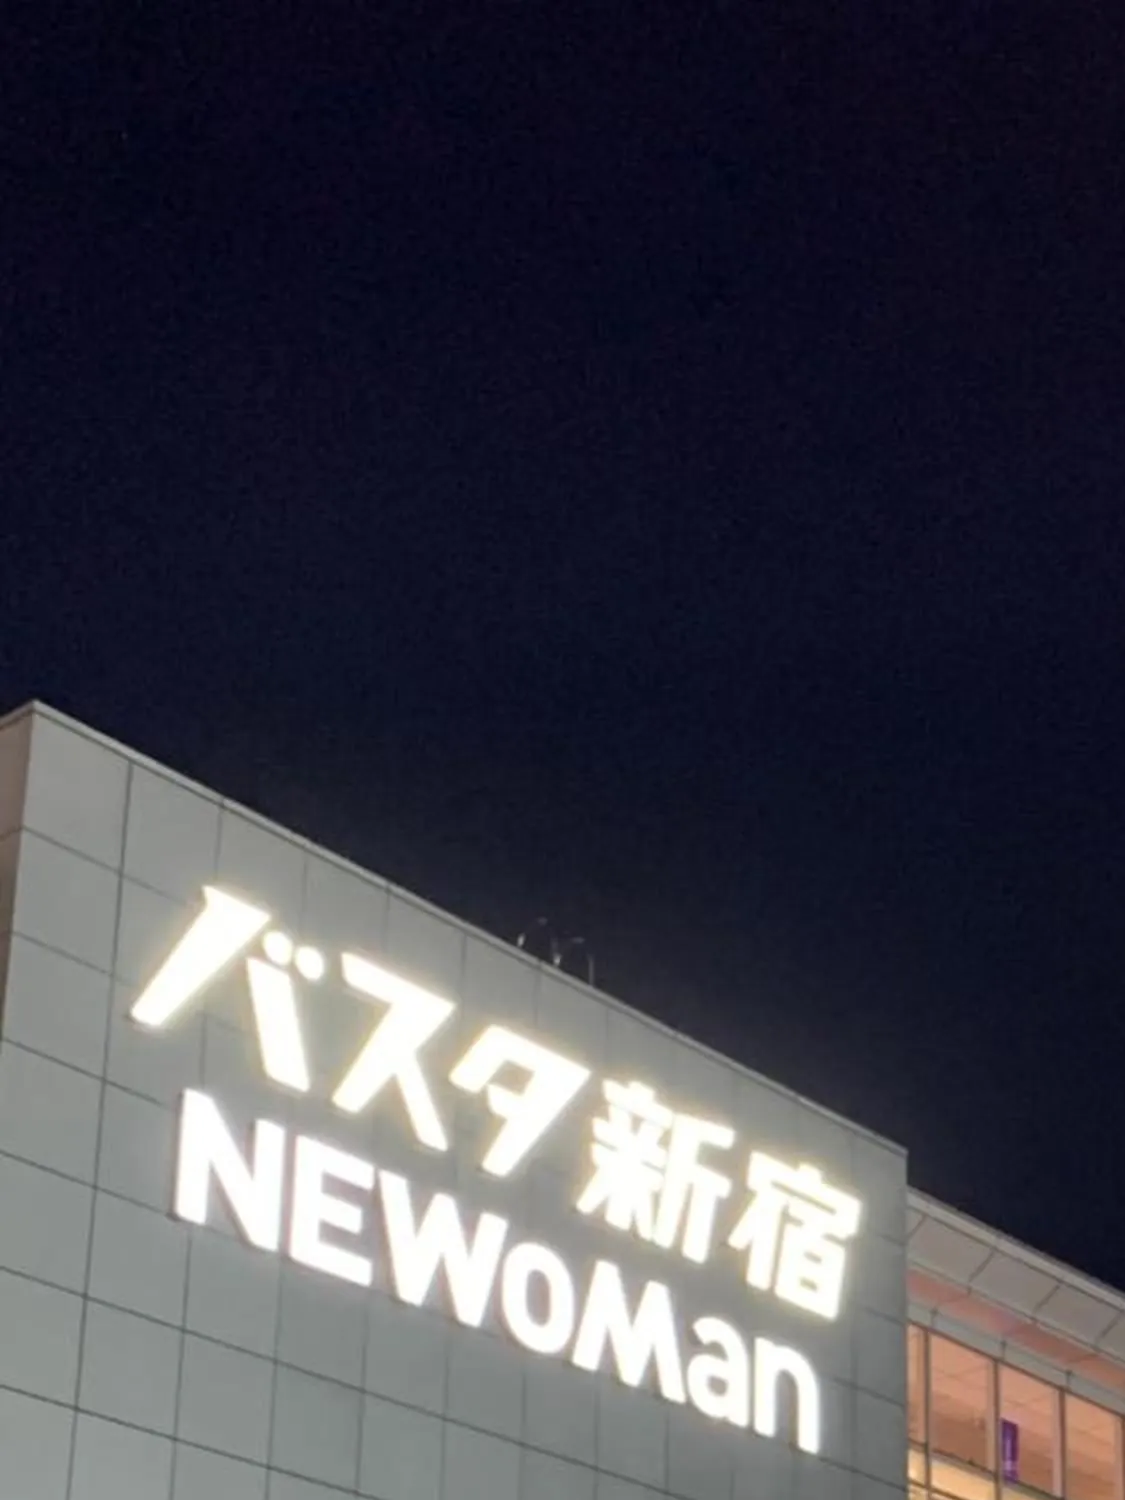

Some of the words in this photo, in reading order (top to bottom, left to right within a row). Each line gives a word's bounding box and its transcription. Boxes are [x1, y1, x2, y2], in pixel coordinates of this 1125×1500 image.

[131, 885, 862, 1320] バスタ新宿
[176, 1088, 820, 1454] NEWoMan
